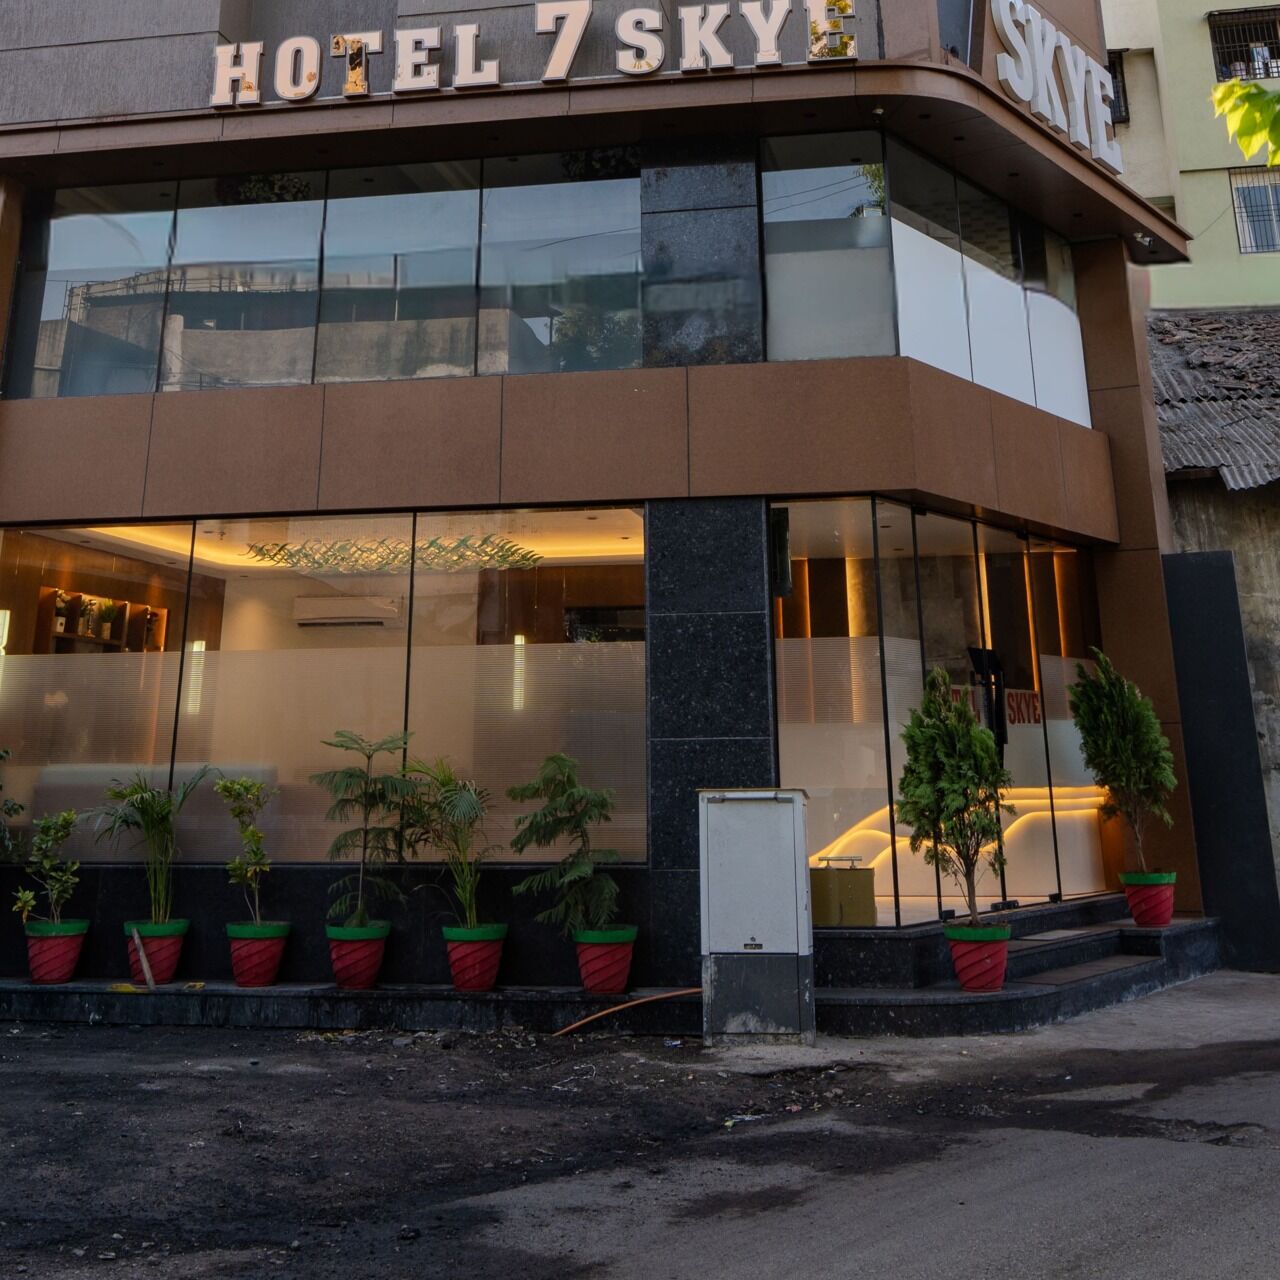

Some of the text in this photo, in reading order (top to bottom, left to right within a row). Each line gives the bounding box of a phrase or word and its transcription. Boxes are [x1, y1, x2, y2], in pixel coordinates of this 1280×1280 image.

[209, 24, 500, 107] HOTEL
[534, 0, 593, 83] 7
[1007, 691, 1041, 725] SKYE
